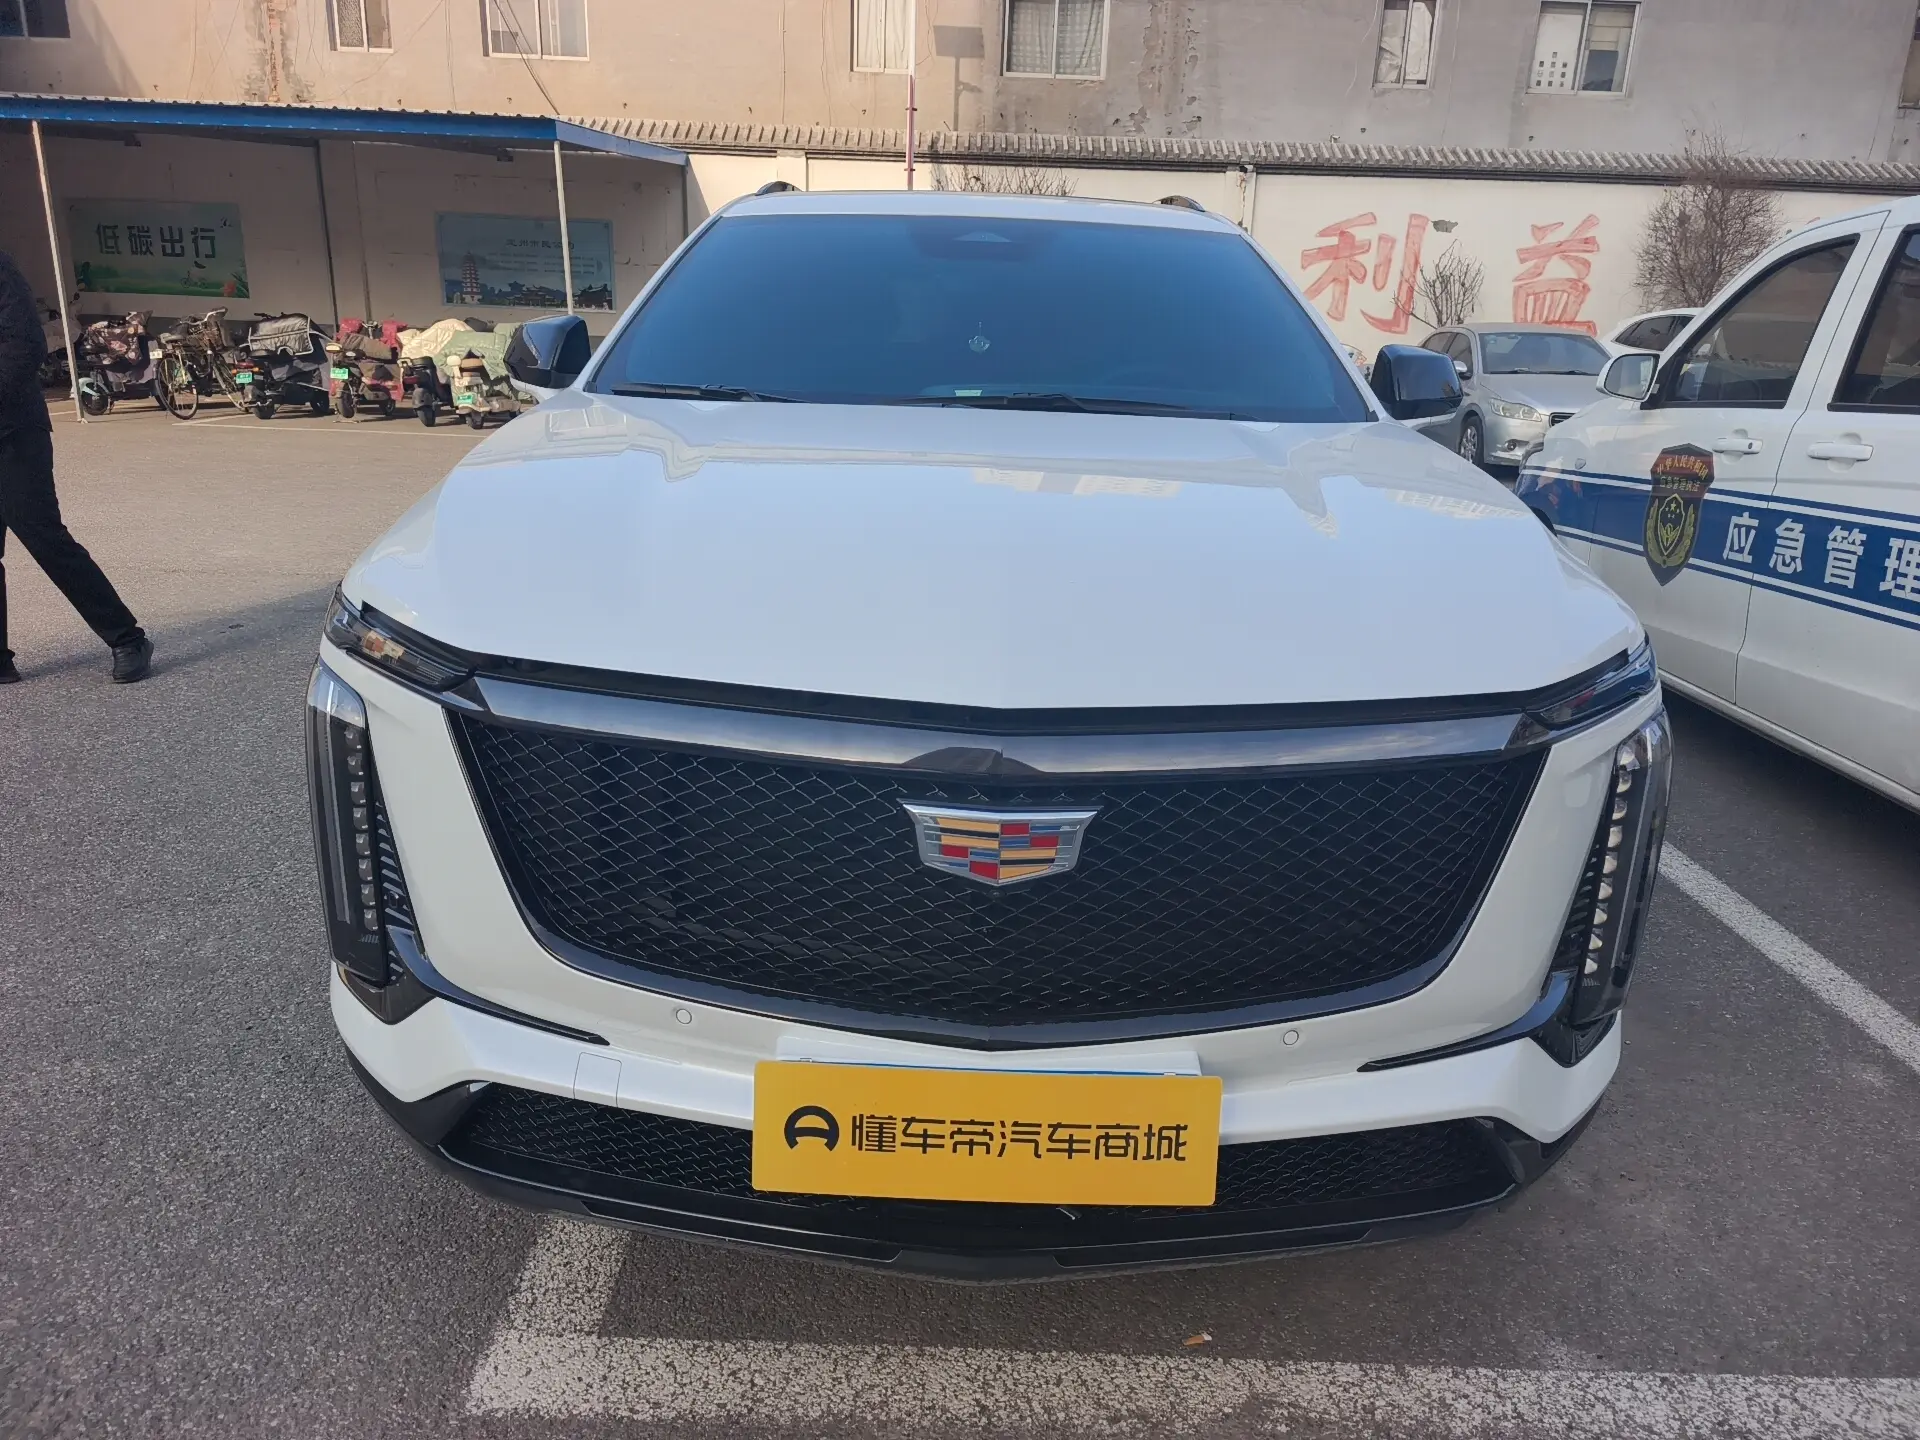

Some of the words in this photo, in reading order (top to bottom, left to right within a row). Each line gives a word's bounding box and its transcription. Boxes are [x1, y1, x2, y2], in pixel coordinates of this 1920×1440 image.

[96, 222, 216, 259] 低碳出行
[1301, 212, 1599, 336] 利益
[1657, 454, 1709, 480] 中华人民共和国
[1722, 511, 1920, 603] 应急管理
[851, 1113, 1188, 1162] 懂车帝汽车商城
